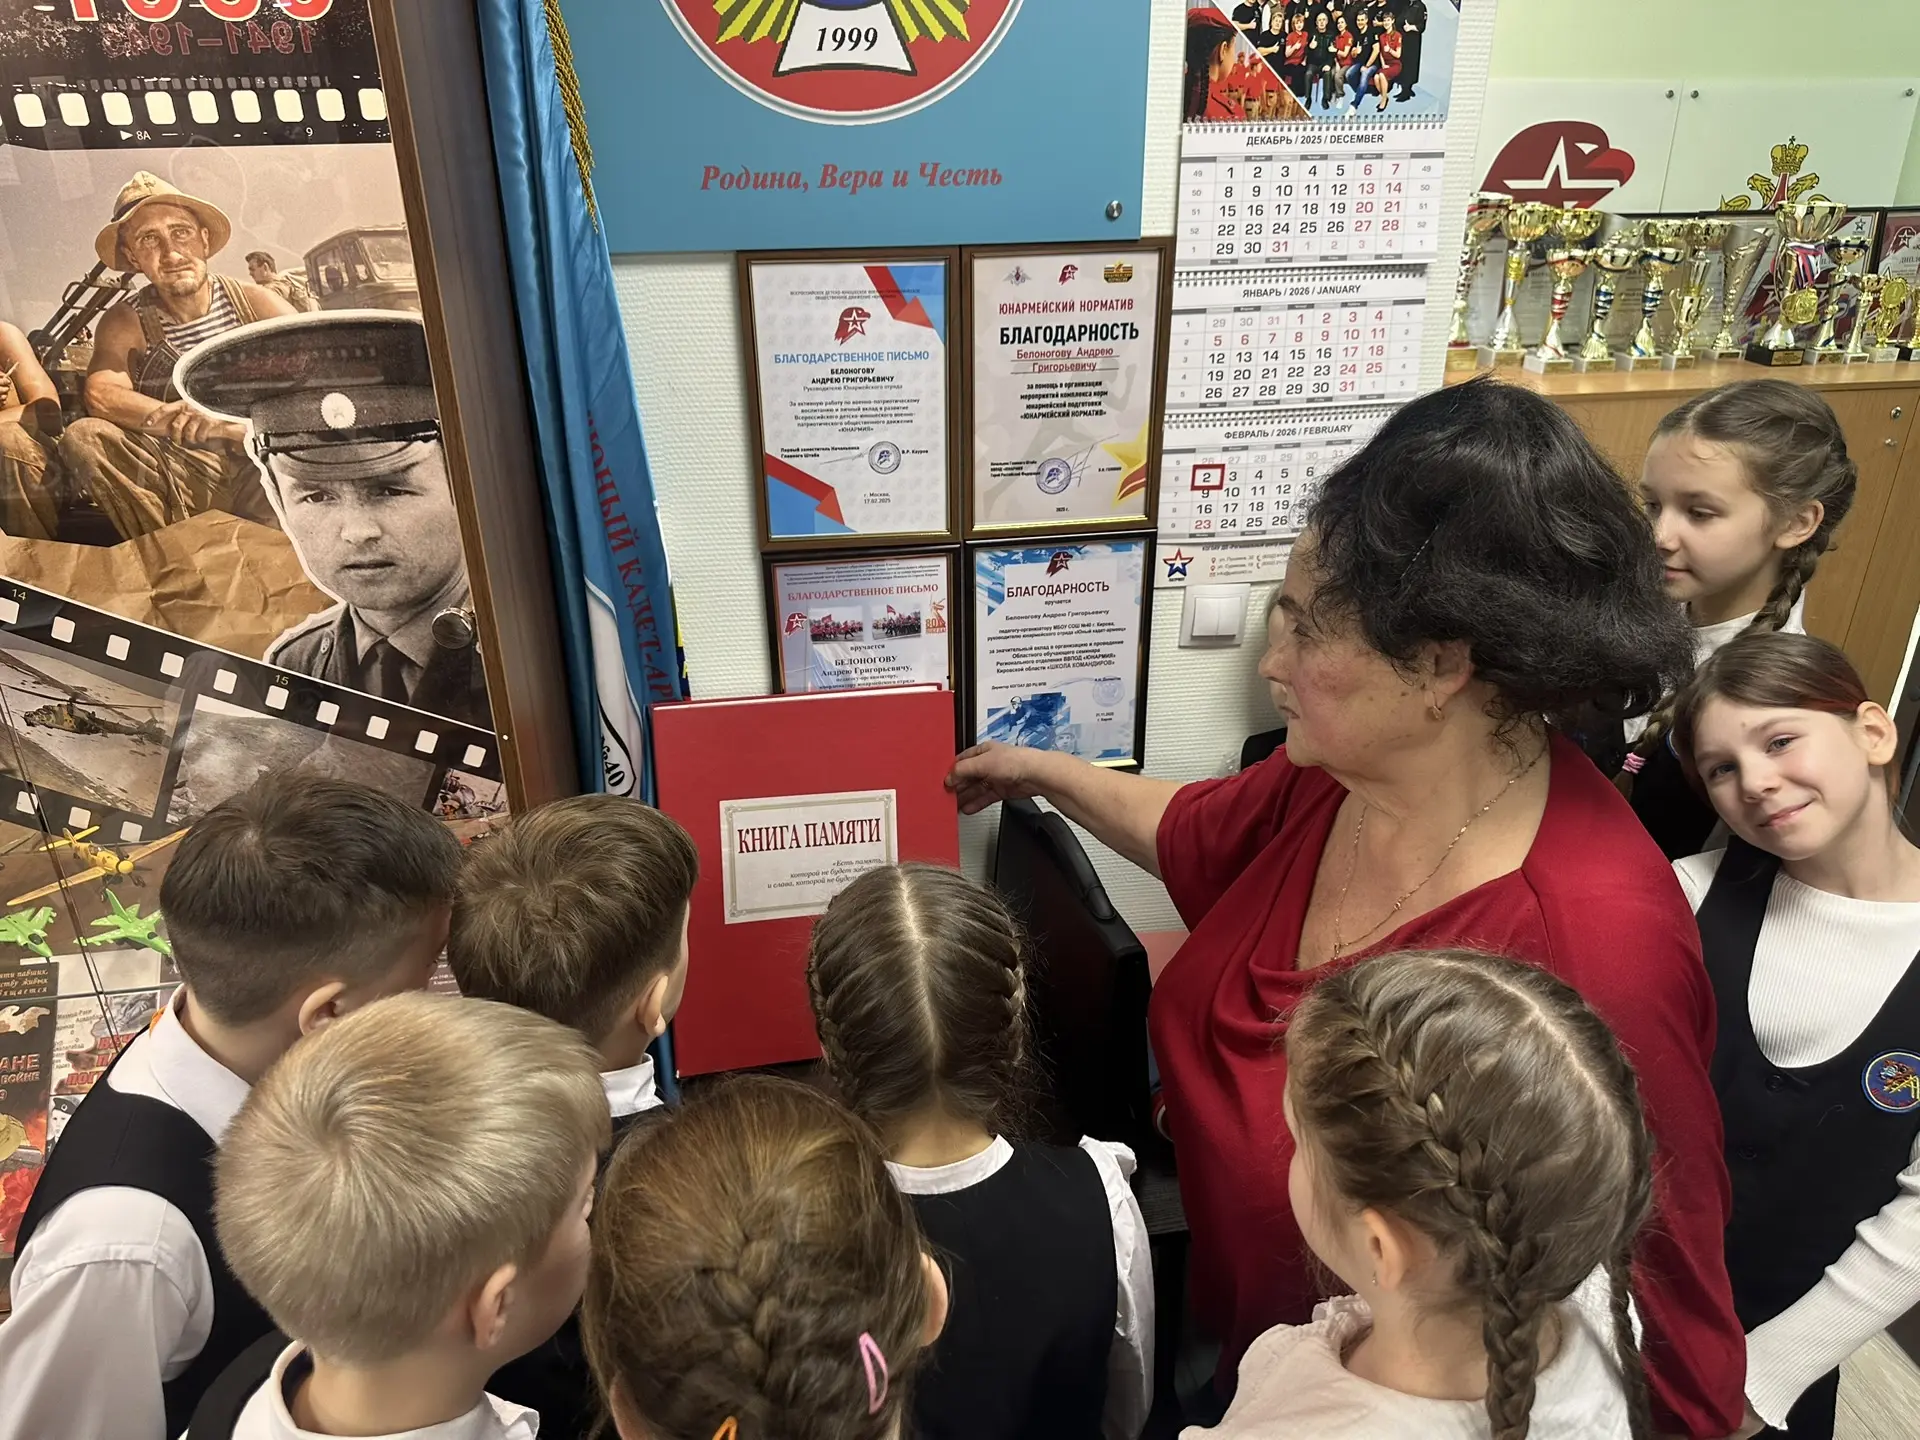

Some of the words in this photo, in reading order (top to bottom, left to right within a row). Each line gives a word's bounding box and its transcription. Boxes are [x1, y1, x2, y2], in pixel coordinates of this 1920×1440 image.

[816, 27, 878, 52] 1999
[136, 129, 151, 141] 8A
[306, 127, 313, 137] 9
[1247, 135, 1292, 146] ДЕКАБРЬ
[1300, 135, 1322, 145] 2025
[1330, 134, 1384, 144] DECEMBER
[1228, 167, 1233, 178] 1
[1254, 167, 1261, 178] 2
[1281, 166, 1289, 177] 3
[1309, 166, 1316, 176] 4
[1337, 165, 1344, 176] 5
[1364, 164, 1372, 175] 6
[1392, 164, 1399, 175] 7
[701, 165, 809, 192] Родина,
[817, 164, 883, 195] Вера
[893, 170, 908, 187] и
[919, 162, 1002, 188] Честь
[1225, 187, 1232, 198] 8
[1253, 186, 1260, 197] 9
[1276, 185, 1292, 196] 10
[1305, 185, 1319, 195] 11
[1332, 184, 1347, 195] 12
[1359, 183, 1374, 194] 13
[1386, 183, 1401, 193] 14
[1220, 205, 1236, 216] 15
[1248, 205, 1263, 216] 16
[1276, 204, 1291, 215] 17
[1303, 203, 1318, 214] 18
[1330, 203, 1345, 214] 19
[1356, 202, 1373, 213] 20
[1385, 201, 1400, 212] 21
[1218, 224, 1235, 236] 22
[1246, 224, 1262, 235] 23
[1273, 223, 1289, 234] 24
[1300, 222, 1316, 233] 25
[1327, 221, 1344, 232] 26
[1355, 220, 1371, 231] 27
[1382, 220, 1399, 231] 28
[1217, 243, 1233, 254] 29
[1244, 242, 1261, 253] 30
[1272, 241, 1288, 252] 31
[1243, 288, 1281, 298] ЯНВАРЬ
[1289, 287, 1309, 296] 2026
[1317, 285, 1361, 295] JANUARY
[999, 300, 1074, 315] ЮНАРМЕЙСКИЙ
[1080, 299, 1133, 312] НОРМАТИВ
[1000, 322, 1139, 346] БЛАГОДАРНОСТЬ
[774, 352, 884, 364] БЛАГОДАРСТВЕННОЕ
[887, 351, 929, 361] ПИСЬМО
[1017, 349, 1071, 360] Белоногову
[1077, 347, 1113, 358] Андрею
[1032, 362, 1097, 373] Григорьевичу
[1064, 380, 1102, 389] организации
[1020, 392, 1059, 401] мероприятий
[1060, 391, 1092, 399] комплекса
[1026, 401, 1066, 410] юнармейской
[1068, 400, 1101, 409] подготовки
[1020, 409, 1069, 419] «ЮНАРМЕЙСКИЙ
[1071, 410, 1106, 418] НОРМАТИВ»
[1225, 429, 1269, 438] ФЕВРАЛЬ
[1277, 428, 1296, 436] 2026
[1304, 425, 1352, 435] FEBRUARY
[1203, 474, 1210, 482] 2
[1229, 472, 1237, 480] 3
[1255, 470, 1262, 479] 4
[1281, 468, 1288, 478] 5
[1307, 467, 1314, 476] 6
[1202, 489, 1209, 498] 9
[1225, 487, 1239, 497] 10
[1251, 486, 1264, 495] 11
[1276, 484, 1291, 494] 12
[1197, 504, 1212, 514] 16
[1223, 503, 1238, 513] 17
[1249, 502, 1264, 511] 18
[1275, 500, 1289, 510] 19
[1195, 520, 1211, 529] 23
[1221, 519, 1236, 528] 24
[1246, 517, 1262, 527] 25
[1272, 516, 1288, 525] 26
[11, 589, 27, 601] 14
[788, 588, 894, 601] БЛАГОДАРСТВЕННОЕ
[897, 584, 938, 594] ПИСЬМО
[1007, 581, 1109, 598] БЛАГОДАРНОСТЬ
[1043, 612, 1066, 620] Андрею
[1068, 609, 1109, 618] Григорьевичу
[835, 656, 897, 666] БЕЛОНОГОВУ
[822, 669, 852, 677] Андрею
[275, 674, 289, 686] 15
[738, 824, 801, 854] КНИГА
[804, 818, 881, 848] ПАМЯТИ
[791, 870, 820, 879] которой
[830, 866, 852, 877] будет
[773, 881, 795, 889] слава,
[796, 877, 825, 886] которой
[1, 1071, 40, 1084] ВОЙНЕ
